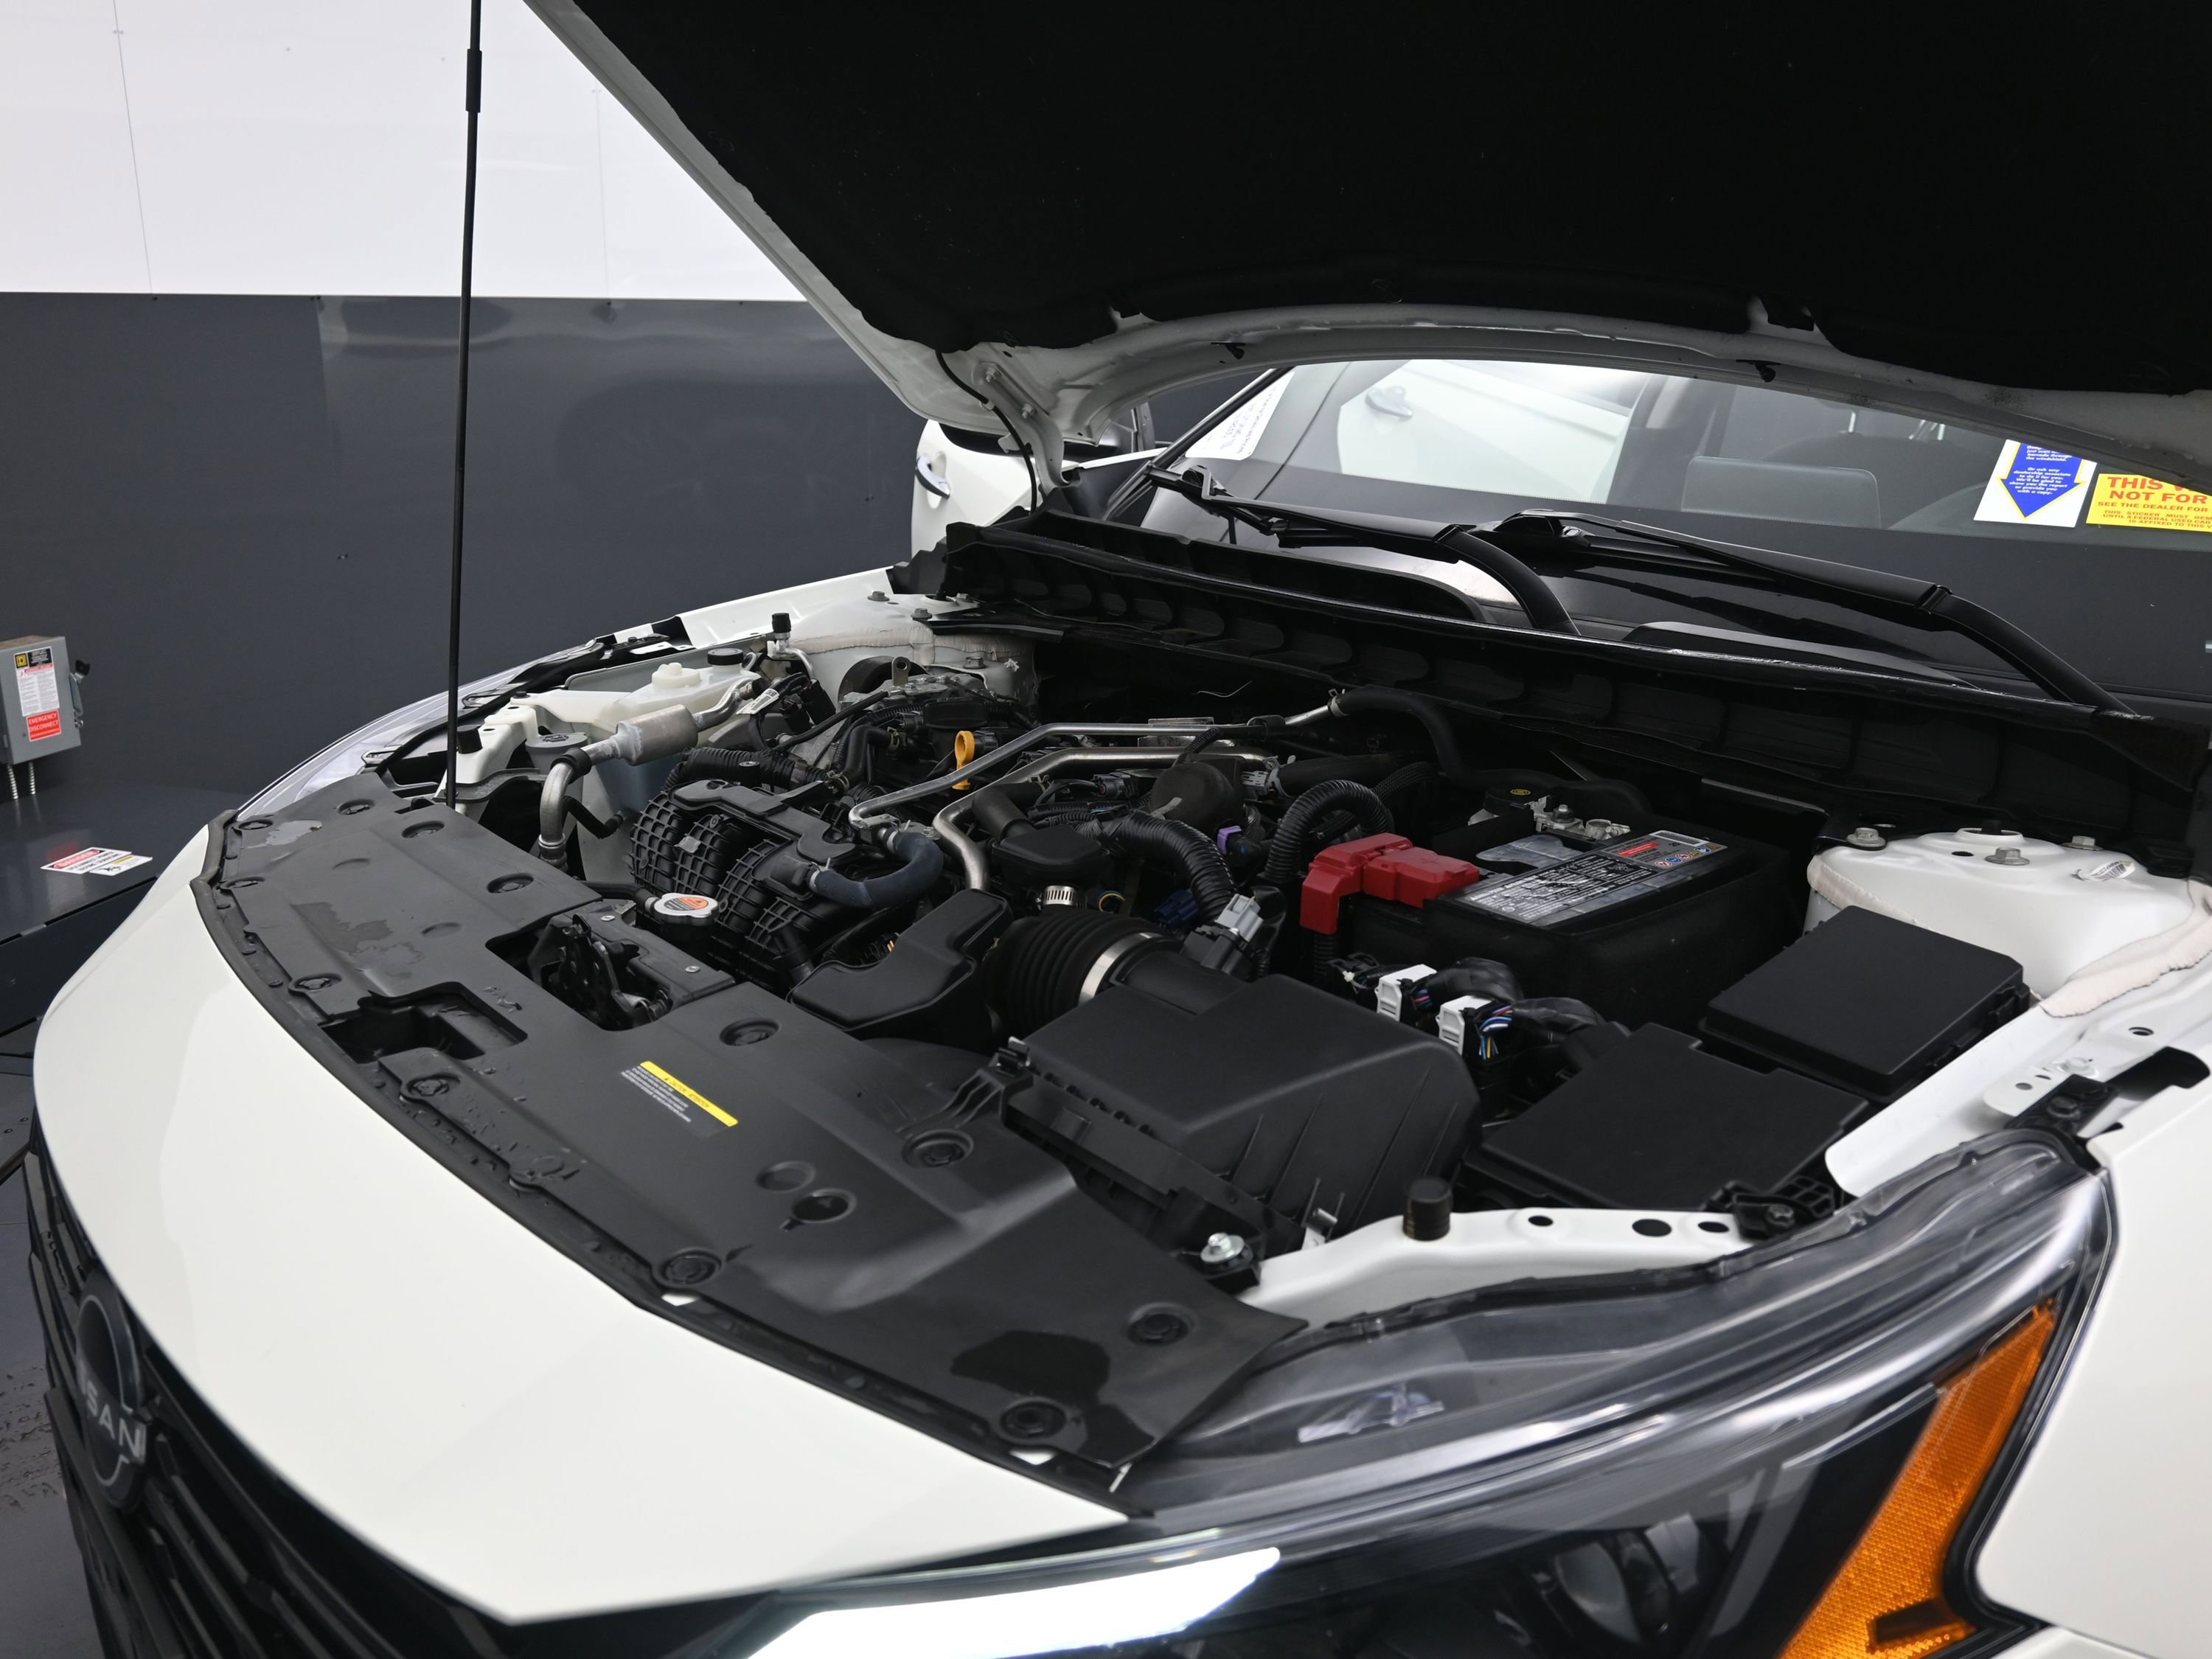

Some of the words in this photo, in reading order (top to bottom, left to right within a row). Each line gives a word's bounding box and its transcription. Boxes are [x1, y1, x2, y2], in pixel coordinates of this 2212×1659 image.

[2107, 476, 2163, 490] THIS
[2110, 490, 2154, 501] NOT
[2162, 493, 2208, 504] FOR
[29, 712, 58, 723] EMERGENCY
[29, 719, 59, 732] DISCONNECT
